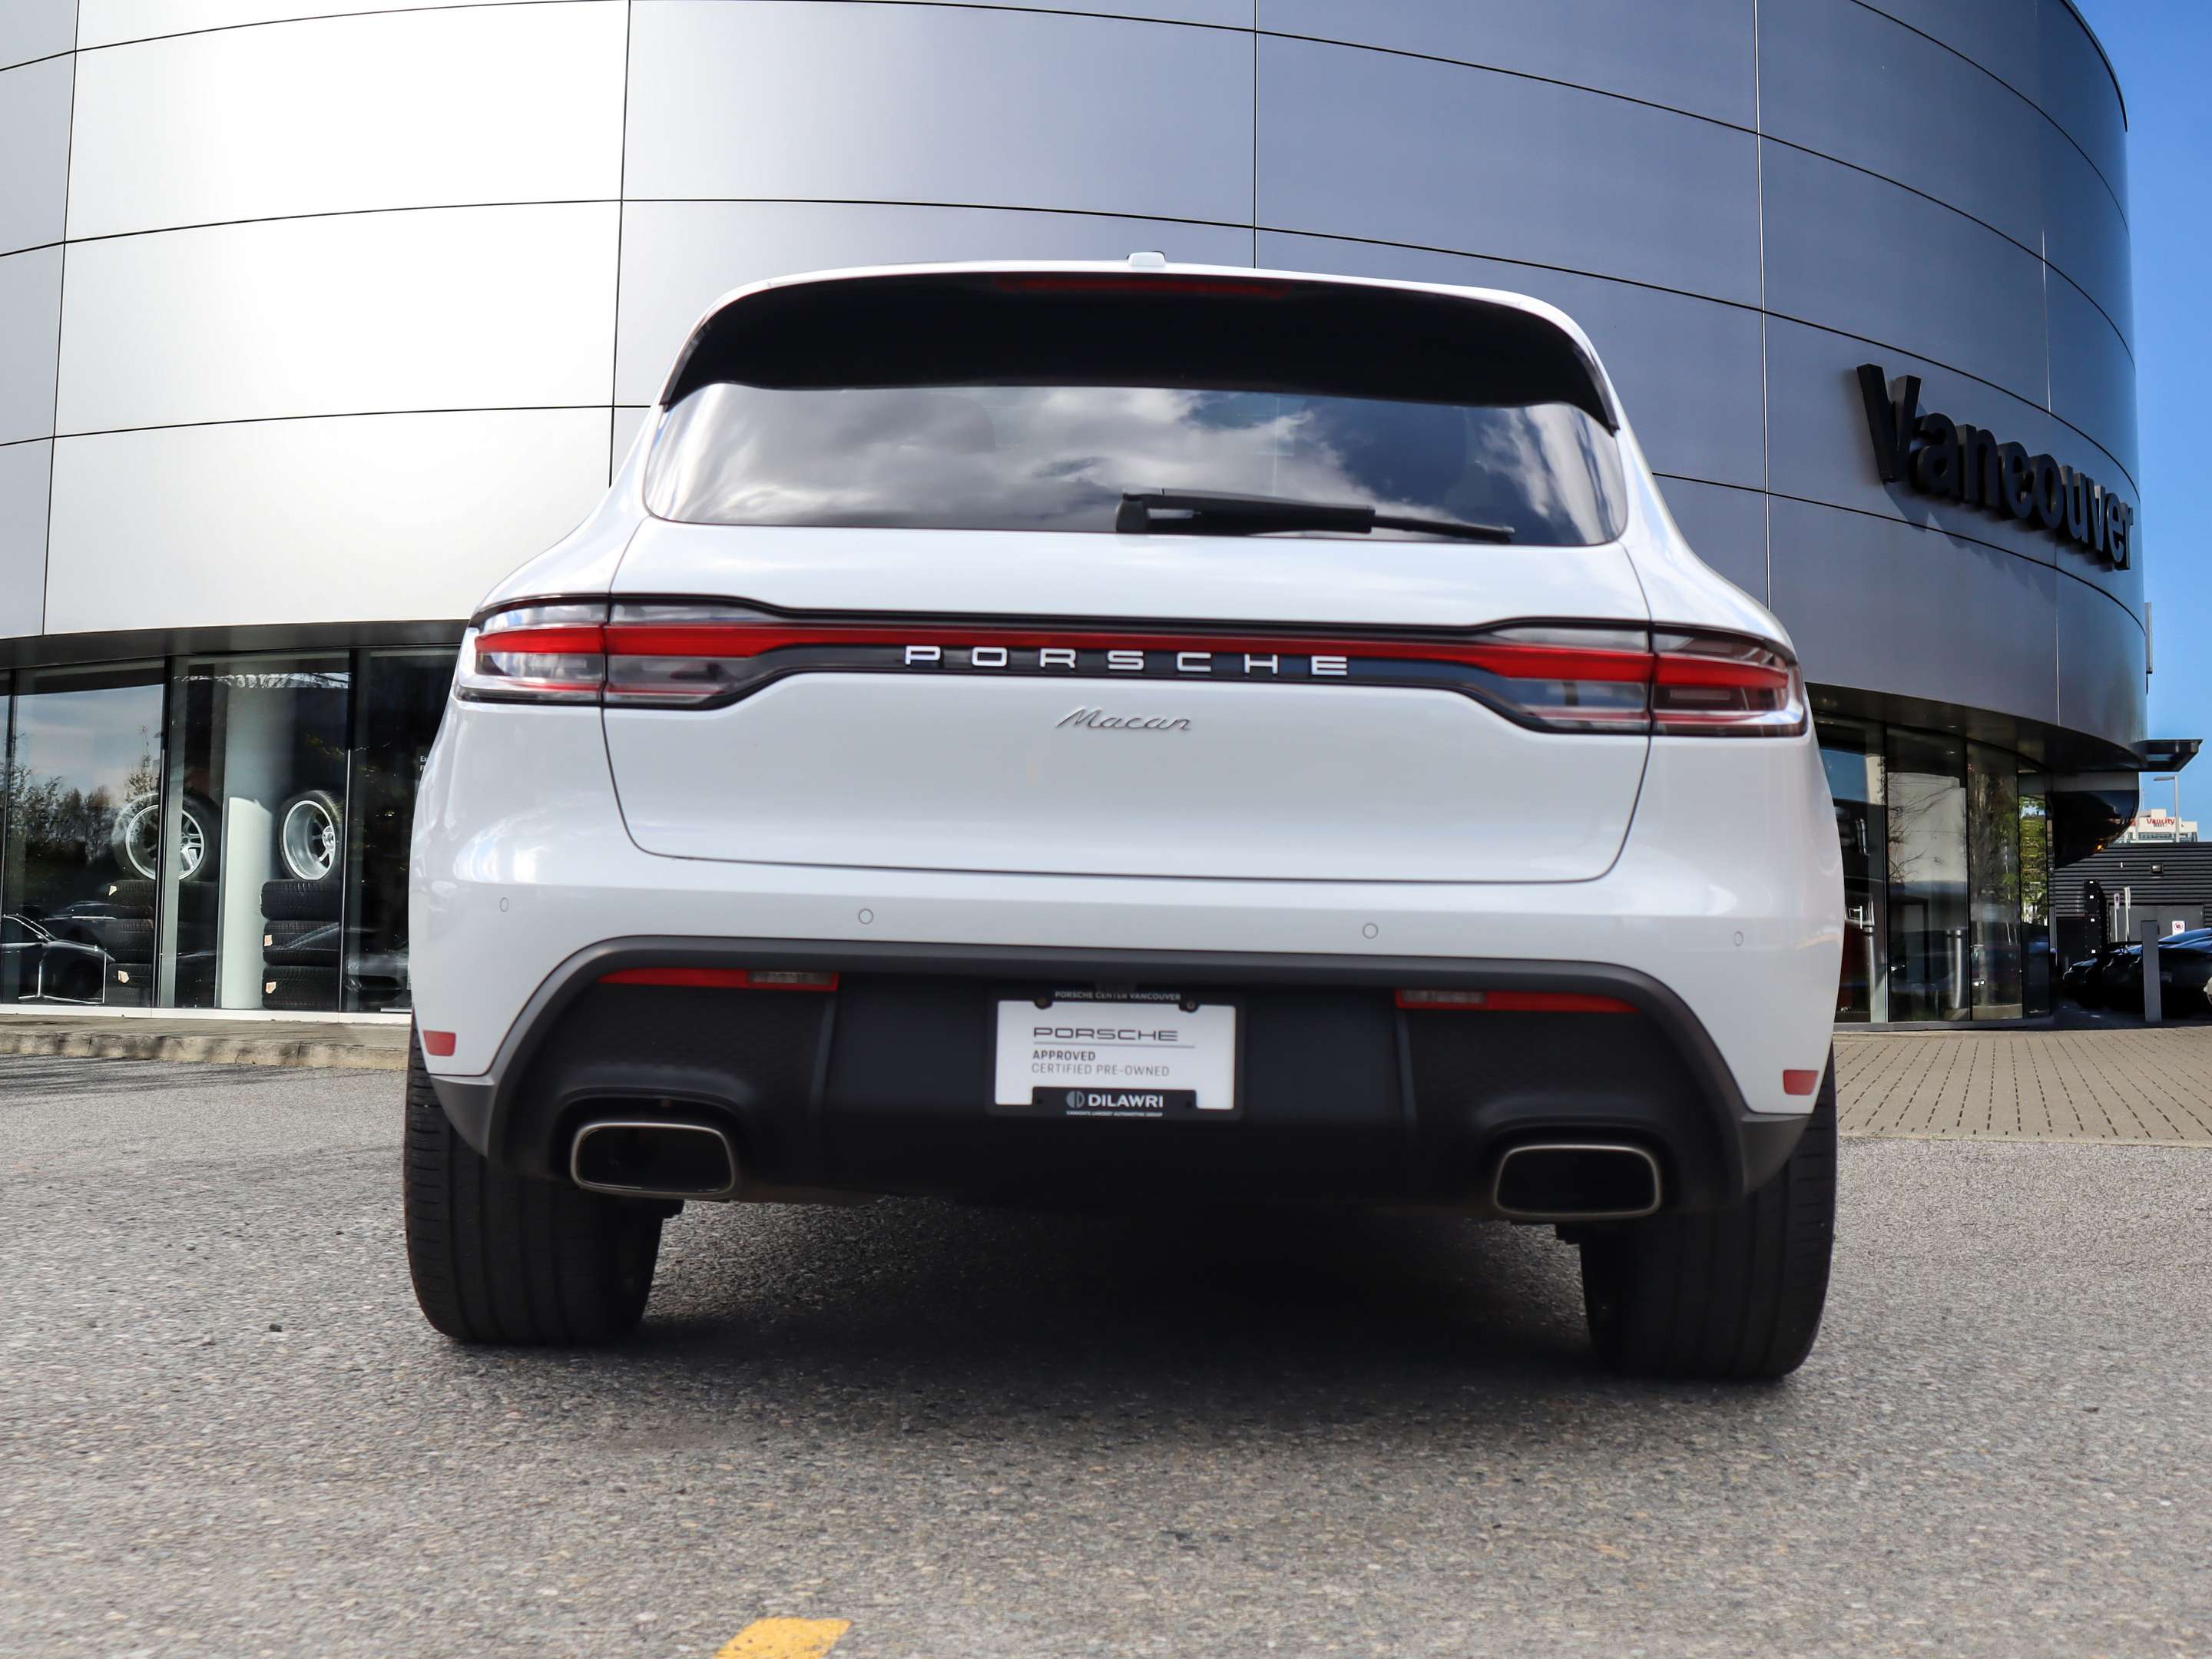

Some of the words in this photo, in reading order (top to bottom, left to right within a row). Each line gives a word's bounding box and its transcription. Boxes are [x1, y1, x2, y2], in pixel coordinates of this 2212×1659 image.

[1856, 363, 2134, 571] Vancouver
[904, 644, 1349, 677] PORSCHE
[1055, 705, 1191, 731] Macan
[1055, 990, 1094, 999] PORSCHE
[1130, 992, 1181, 1002] VANCOUVER
[1033, 1027, 1179, 1041] PORSCHE
[1032, 1050, 1096, 1061] APPROVED
[1031, 1062, 1092, 1075] CERTIFIED
[1096, 1064, 1170, 1077] PRE-OWNED
[1088, 1093, 1164, 1108] DILAWRI
